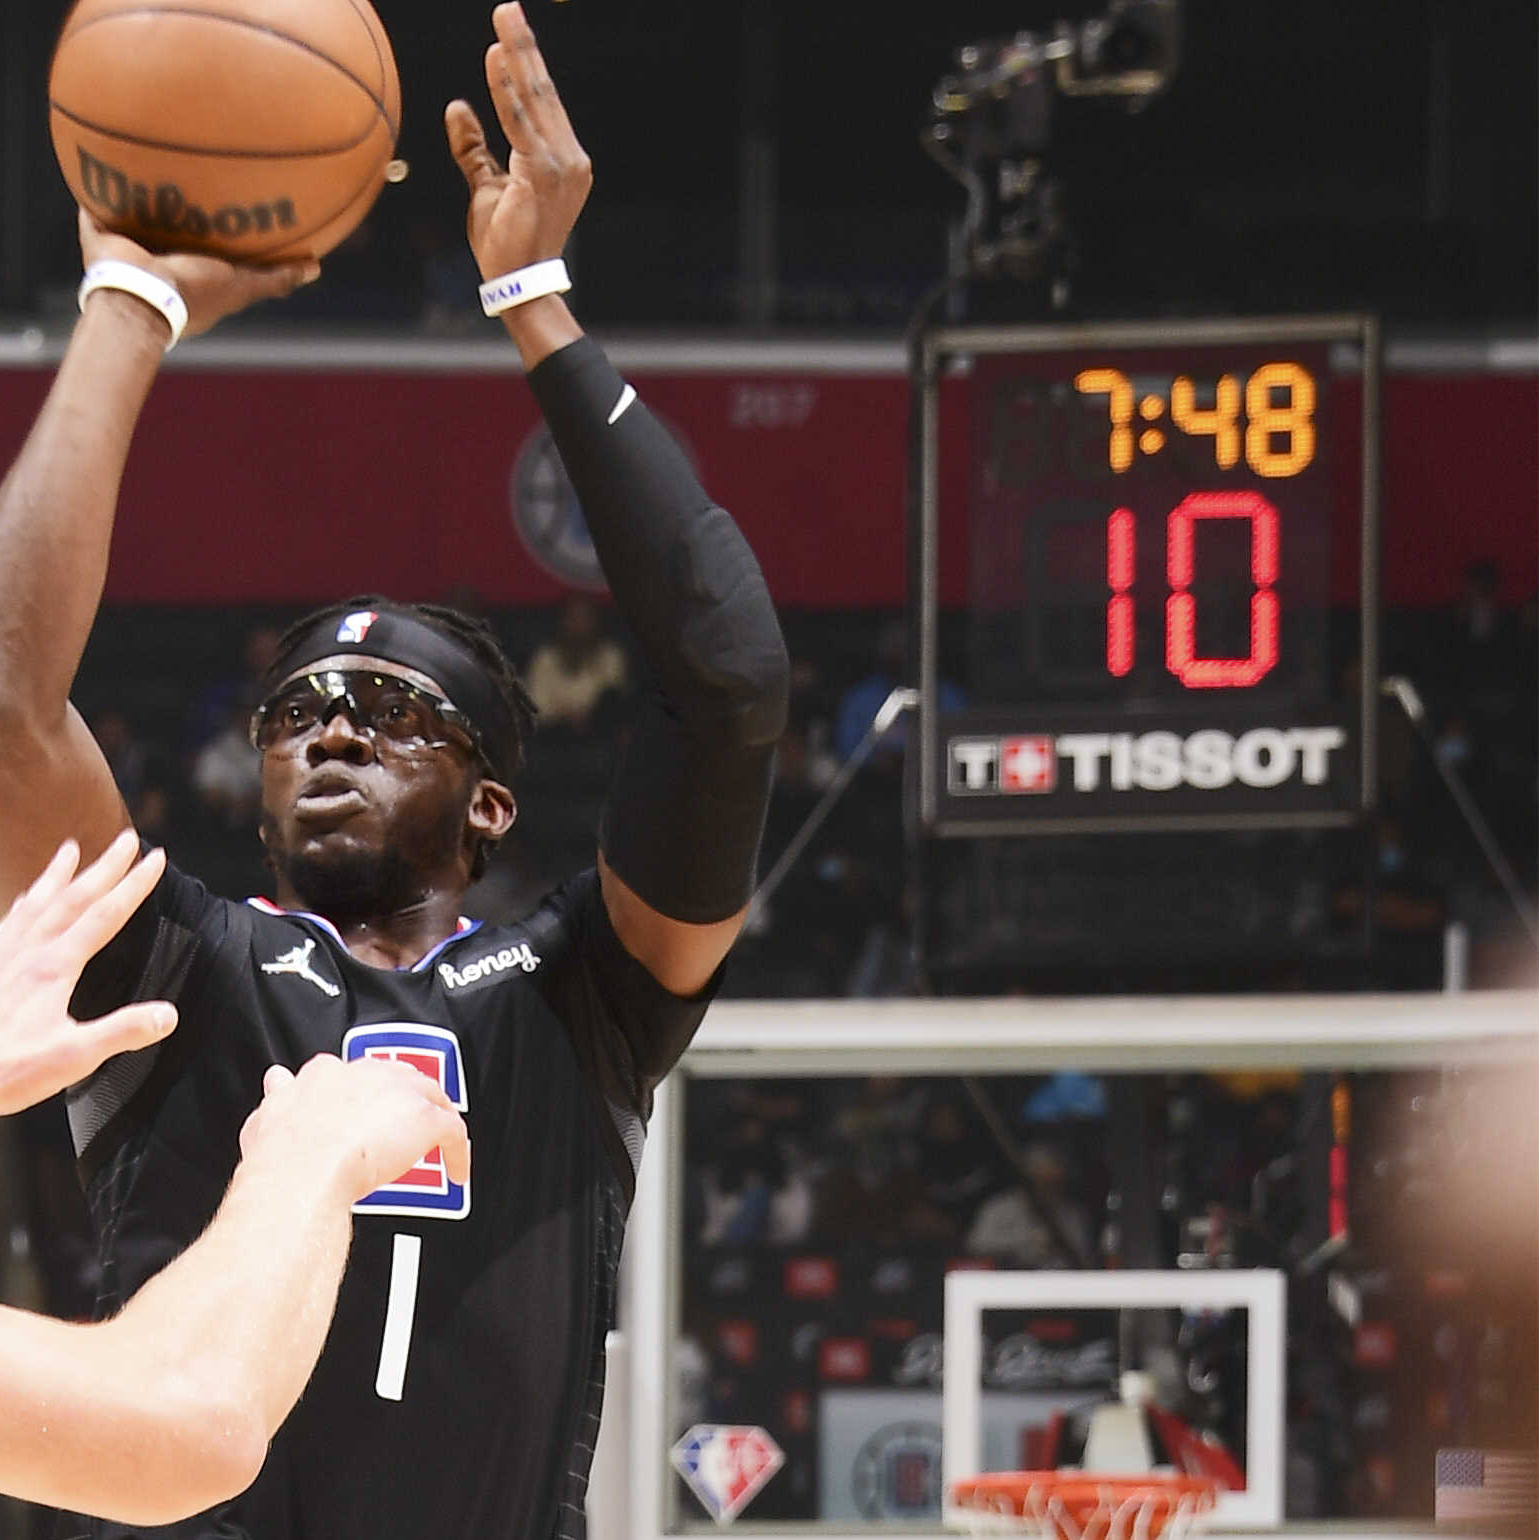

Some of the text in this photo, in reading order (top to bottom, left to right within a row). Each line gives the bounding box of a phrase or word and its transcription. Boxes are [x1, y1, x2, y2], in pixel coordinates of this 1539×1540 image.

[77, 144, 295, 240] Wilson
[1073, 362, 1316, 478] 7:48
[1106, 490, 1280, 689] 10
[1056, 727, 1346, 791] TISSOT
[438, 943, 542, 989] honey
[375, 1233, 422, 1401] 1
